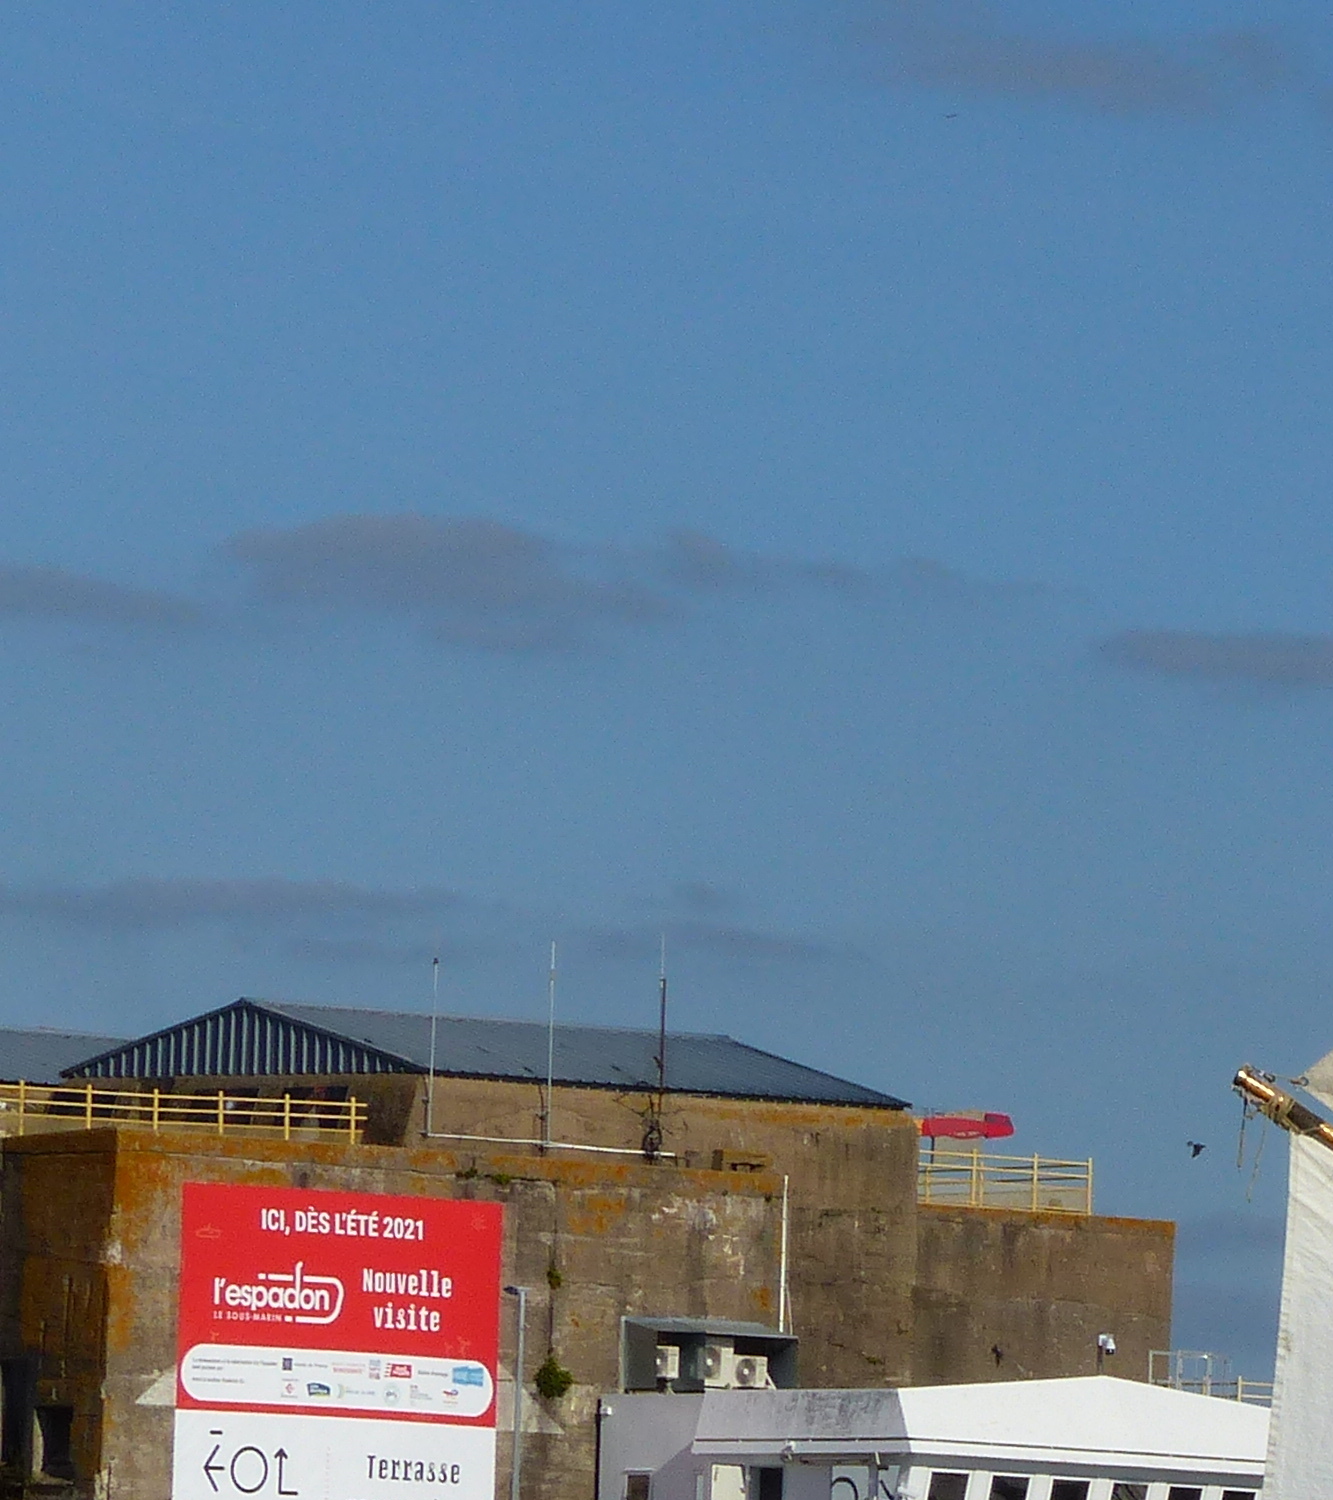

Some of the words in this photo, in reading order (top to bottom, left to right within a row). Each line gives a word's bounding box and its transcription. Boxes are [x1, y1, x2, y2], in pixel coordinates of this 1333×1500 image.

[261, 1208, 291, 1236] ICI,
[295, 1206, 330, 1234] DÈS
[335, 1209, 379, 1237] L'ÉTÉ
[383, 1217, 424, 1240] 2021
[213, 1261, 330, 1311] l'espadon
[363, 1268, 452, 1298] Nouvelle
[373, 1302, 440, 1332] visite
[367, 1455, 460, 1484] Terrasse
